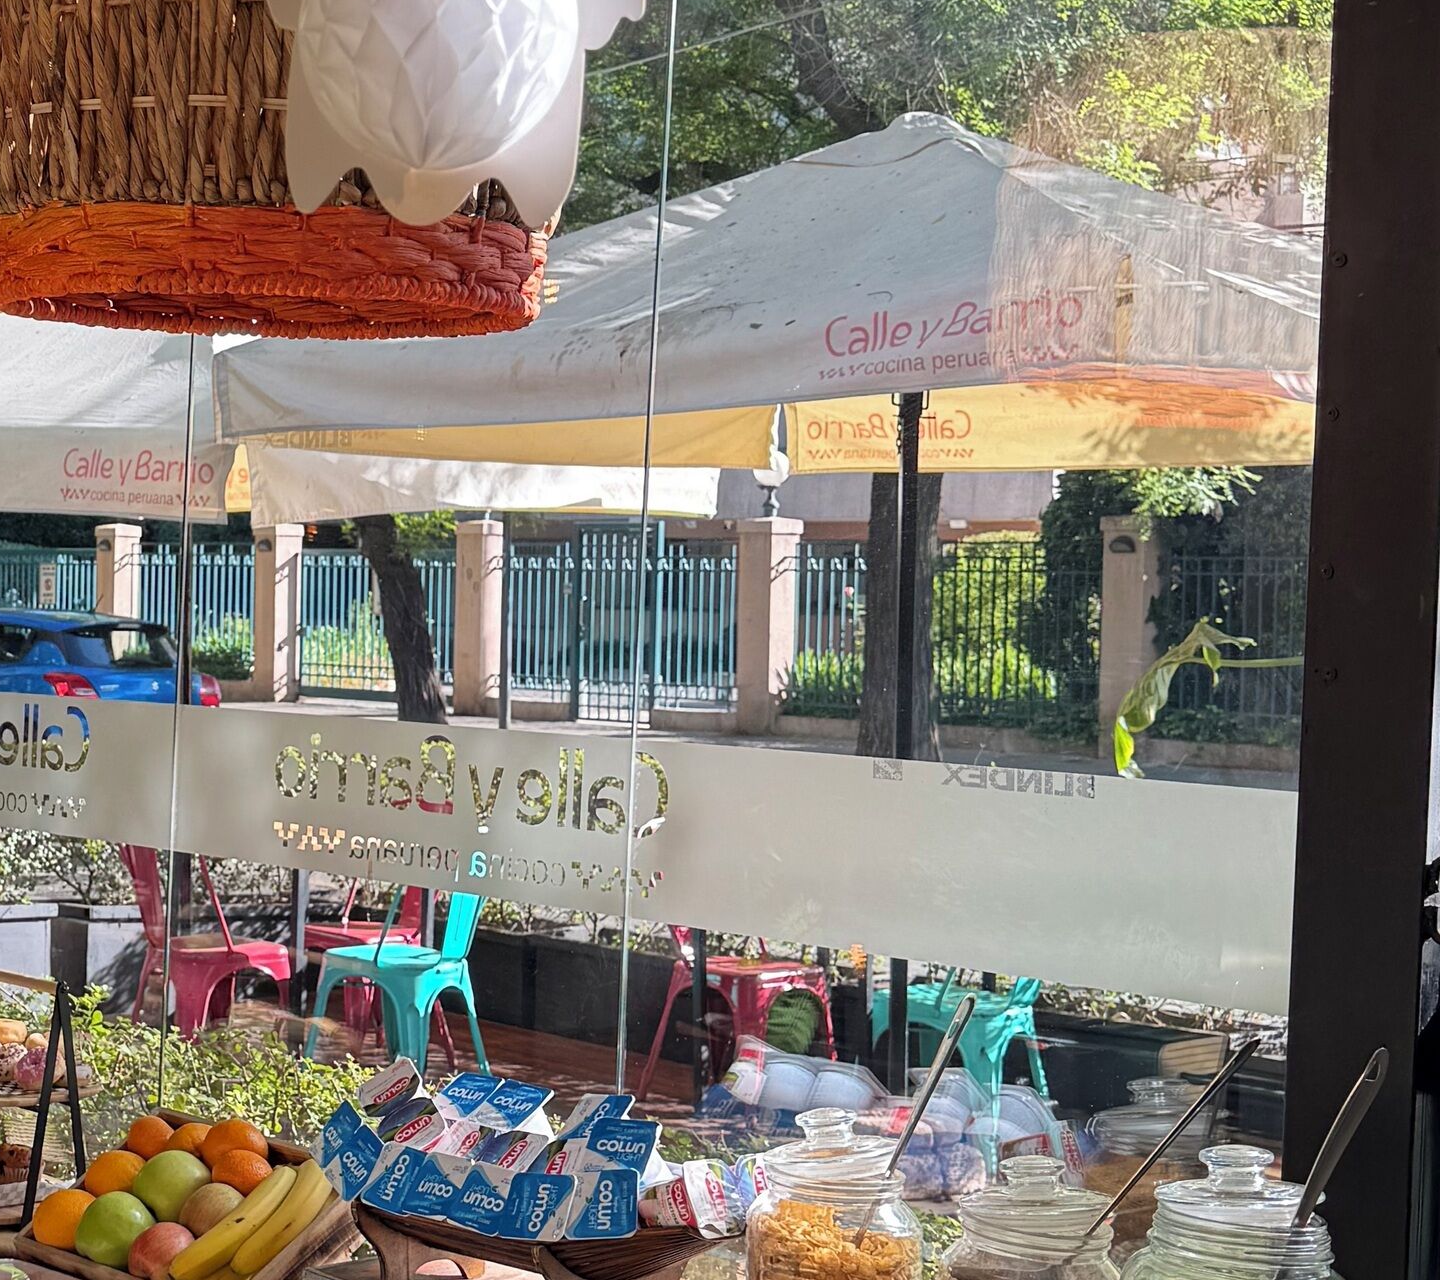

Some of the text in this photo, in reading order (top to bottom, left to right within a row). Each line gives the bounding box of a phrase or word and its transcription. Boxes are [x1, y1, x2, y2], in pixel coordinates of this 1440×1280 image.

[824, 289, 1083, 357] Calle y Barrio
[864, 348, 1015, 375] cocina peruana
[63, 448, 113, 479] Calle
[119, 458, 133, 486] y
[134, 450, 215, 484] Barrio
[90, 489, 174, 506] cocina peruana
[375, 1077, 410, 1104] COLUN
[447, 1087, 486, 1101] COLUN
[493, 1095, 533, 1111] COLUN
[395, 1116, 432, 1143] COLUN
[596, 1138, 647, 1155] COLUN
[342, 1151, 368, 1181] COLUN
[382, 1154, 411, 1201] COLUN
[417, 1180, 453, 1198] COLUN
[463, 1190, 505, 1212] COLUN
[674, 1183, 690, 1221] COLUN
[528, 1184, 551, 1232] COLUN
[597, 1180, 613, 1230] COLUN
